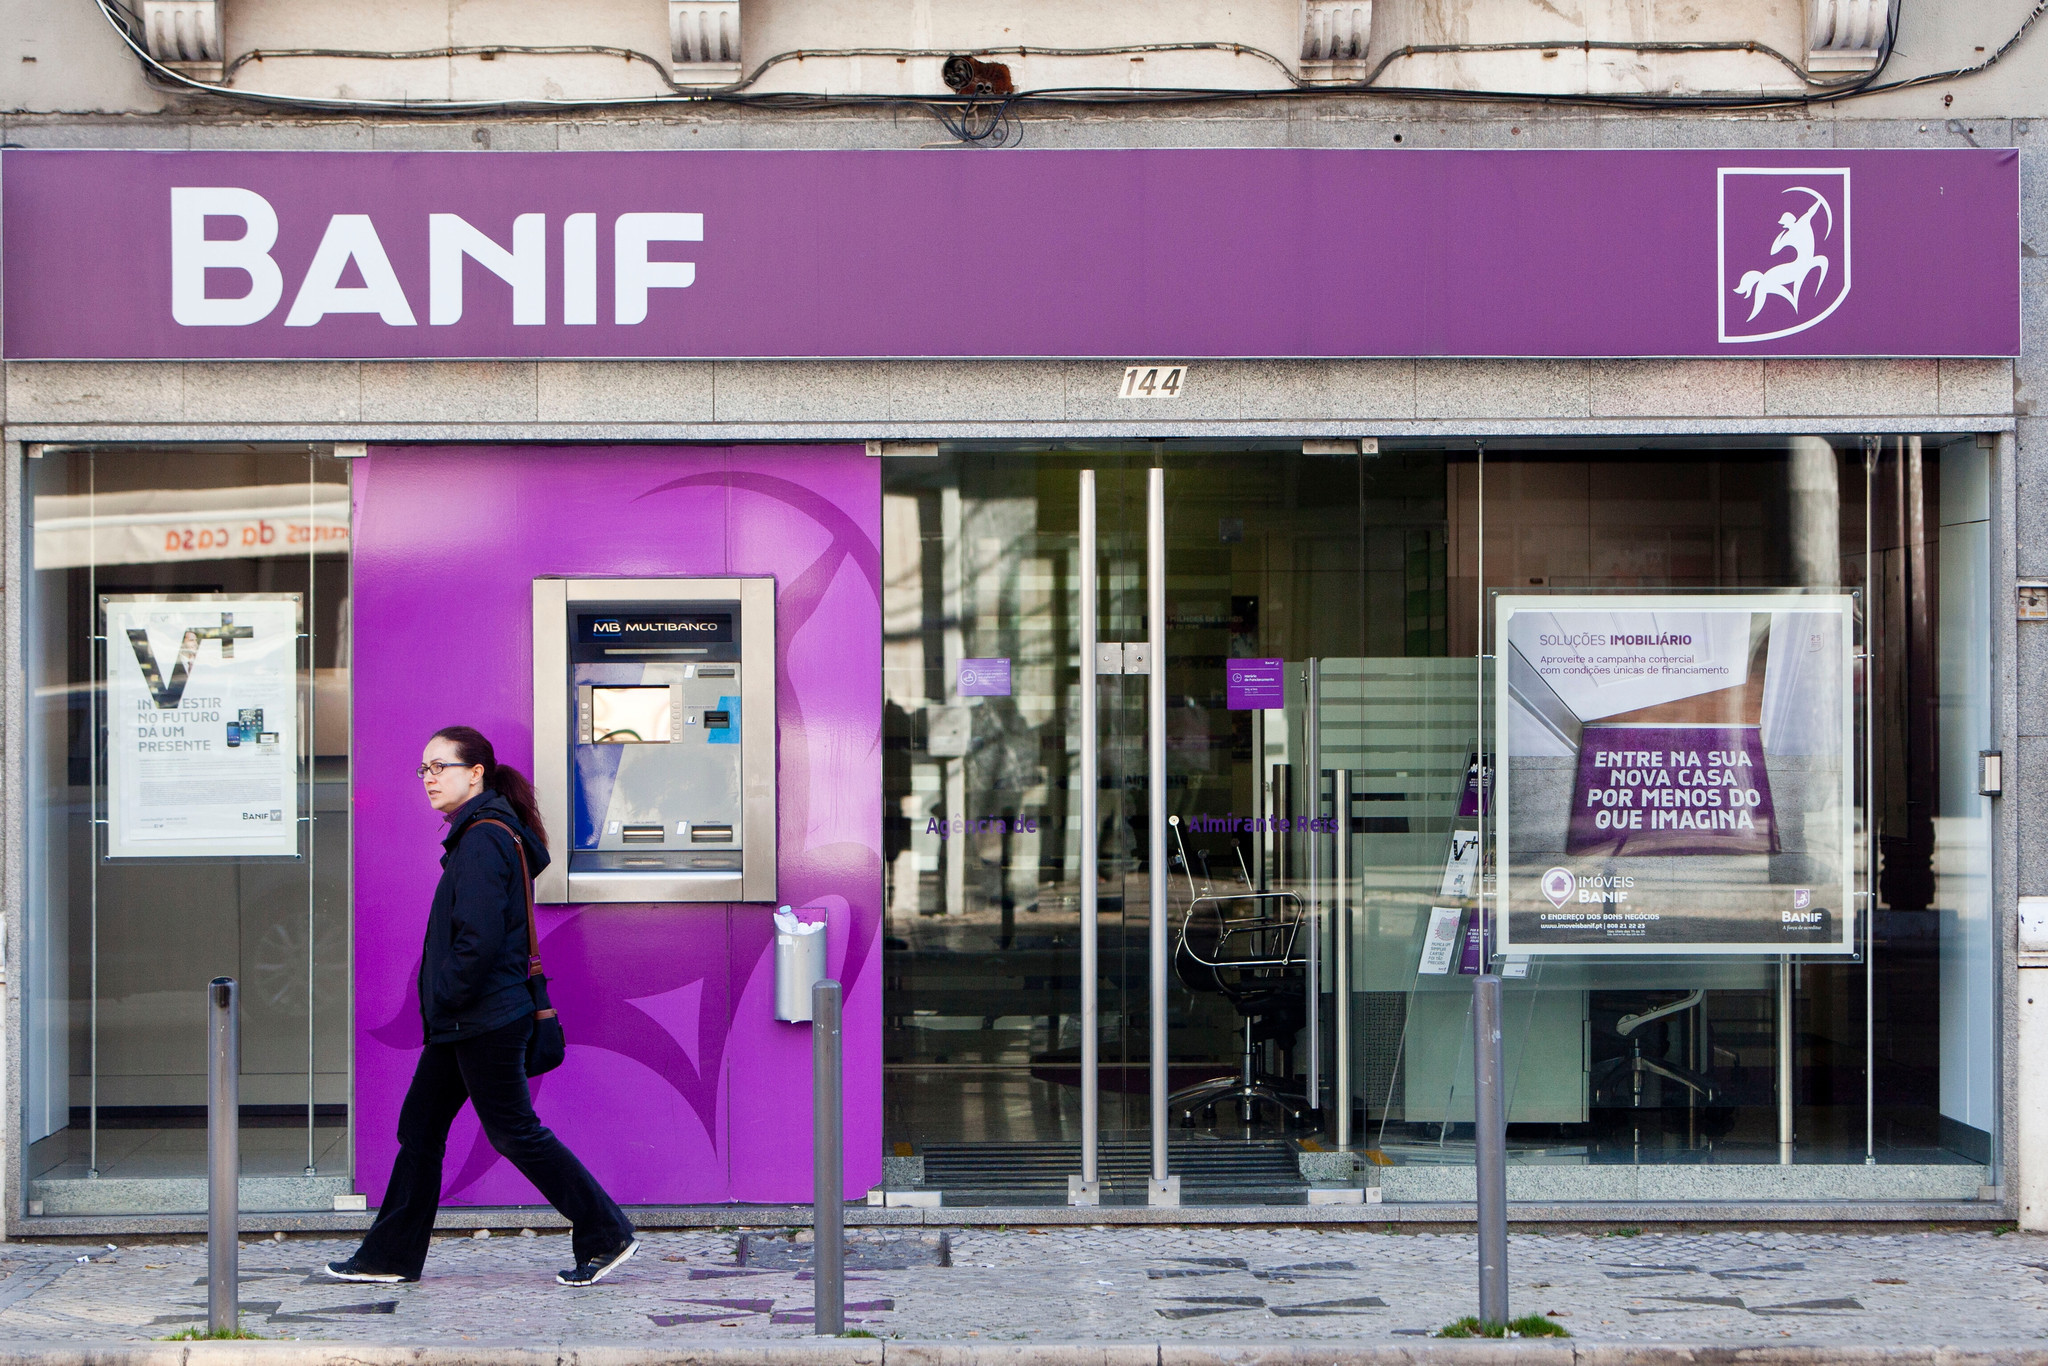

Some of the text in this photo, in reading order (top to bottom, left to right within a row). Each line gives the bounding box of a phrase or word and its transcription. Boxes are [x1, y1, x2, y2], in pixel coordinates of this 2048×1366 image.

[170, 186, 704, 326] BANIF
[1125, 369, 1182, 395] 144
[593, 622, 718, 632] MB MULTIBANCO
[1540, 632, 1692, 648] SOLUÇÕES IMOBILIÁRIO
[1540, 655, 1585, 666] Aproveite
[1597, 655, 1646, 666] campanha
[1648, 655, 1695, 664] comercial
[1563, 665, 1611, 677] condições
[1613, 665, 1645, 675] únicas
[1646, 666, 1659, 675] de
[1662, 665, 1729, 675] financiamento
[137, 711, 220, 724] NO FUTURO
[162, 726, 185, 738] UM
[138, 740, 211, 752] PRESENTE
[1594, 751, 1753, 768] ENTRE NA SUA
[1610, 769, 1738, 787] NOVA CASA
[1587, 788, 1761, 807] POR MENOS DO
[242, 812, 269, 820] BANIF
[1595, 809, 1755, 830] QUE IMAGINA
[926, 812, 1340, 840] Agência de Almirante Reis
[1579, 873, 1634, 888] IMÓVEIS
[1579, 889, 1628, 904] BANIF
[1547, 914, 1585, 922] ENDEREÇO
[1624, 912, 1660, 920] NEGÓCIOS
[1781, 911, 1822, 922] BANIF
[1540, 922, 1603, 930] www.imoveisbanif.pt
